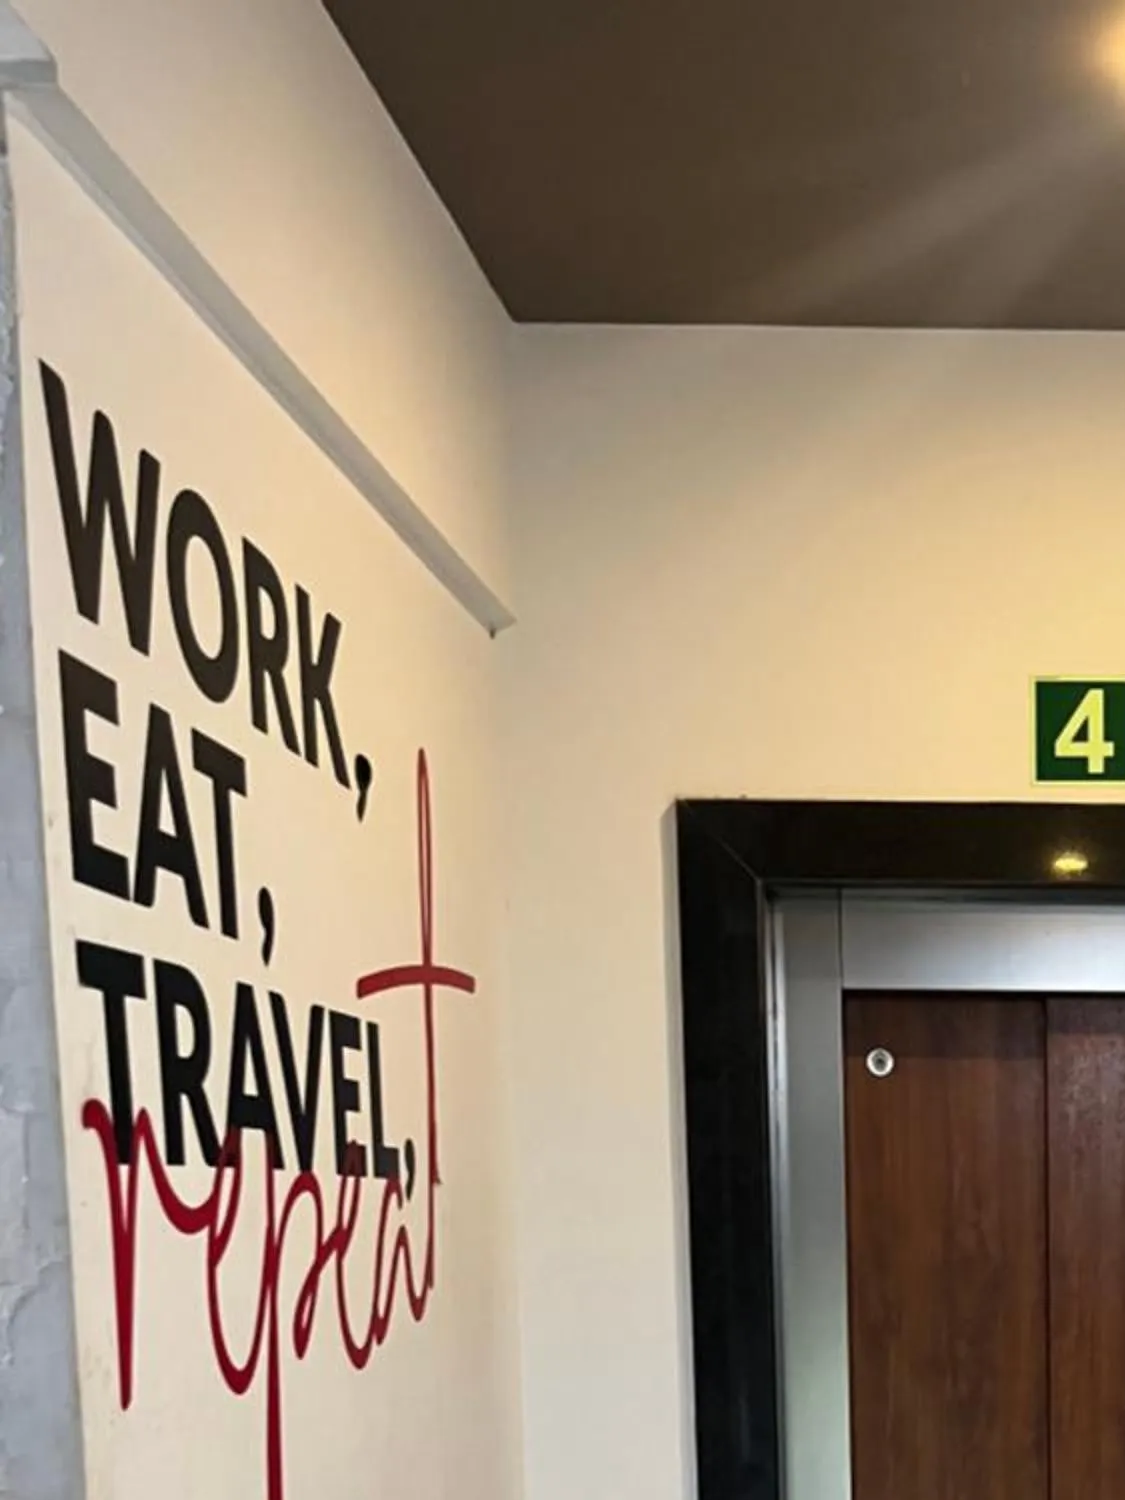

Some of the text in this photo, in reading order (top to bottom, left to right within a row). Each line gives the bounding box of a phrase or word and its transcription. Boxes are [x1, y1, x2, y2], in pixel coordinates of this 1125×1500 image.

[38, 357, 373, 822] WORK,
[1055, 689, 1114, 774] 4
[57, 648, 275, 967] EAT,
[75, 939, 417, 1208] TRAVEL,
